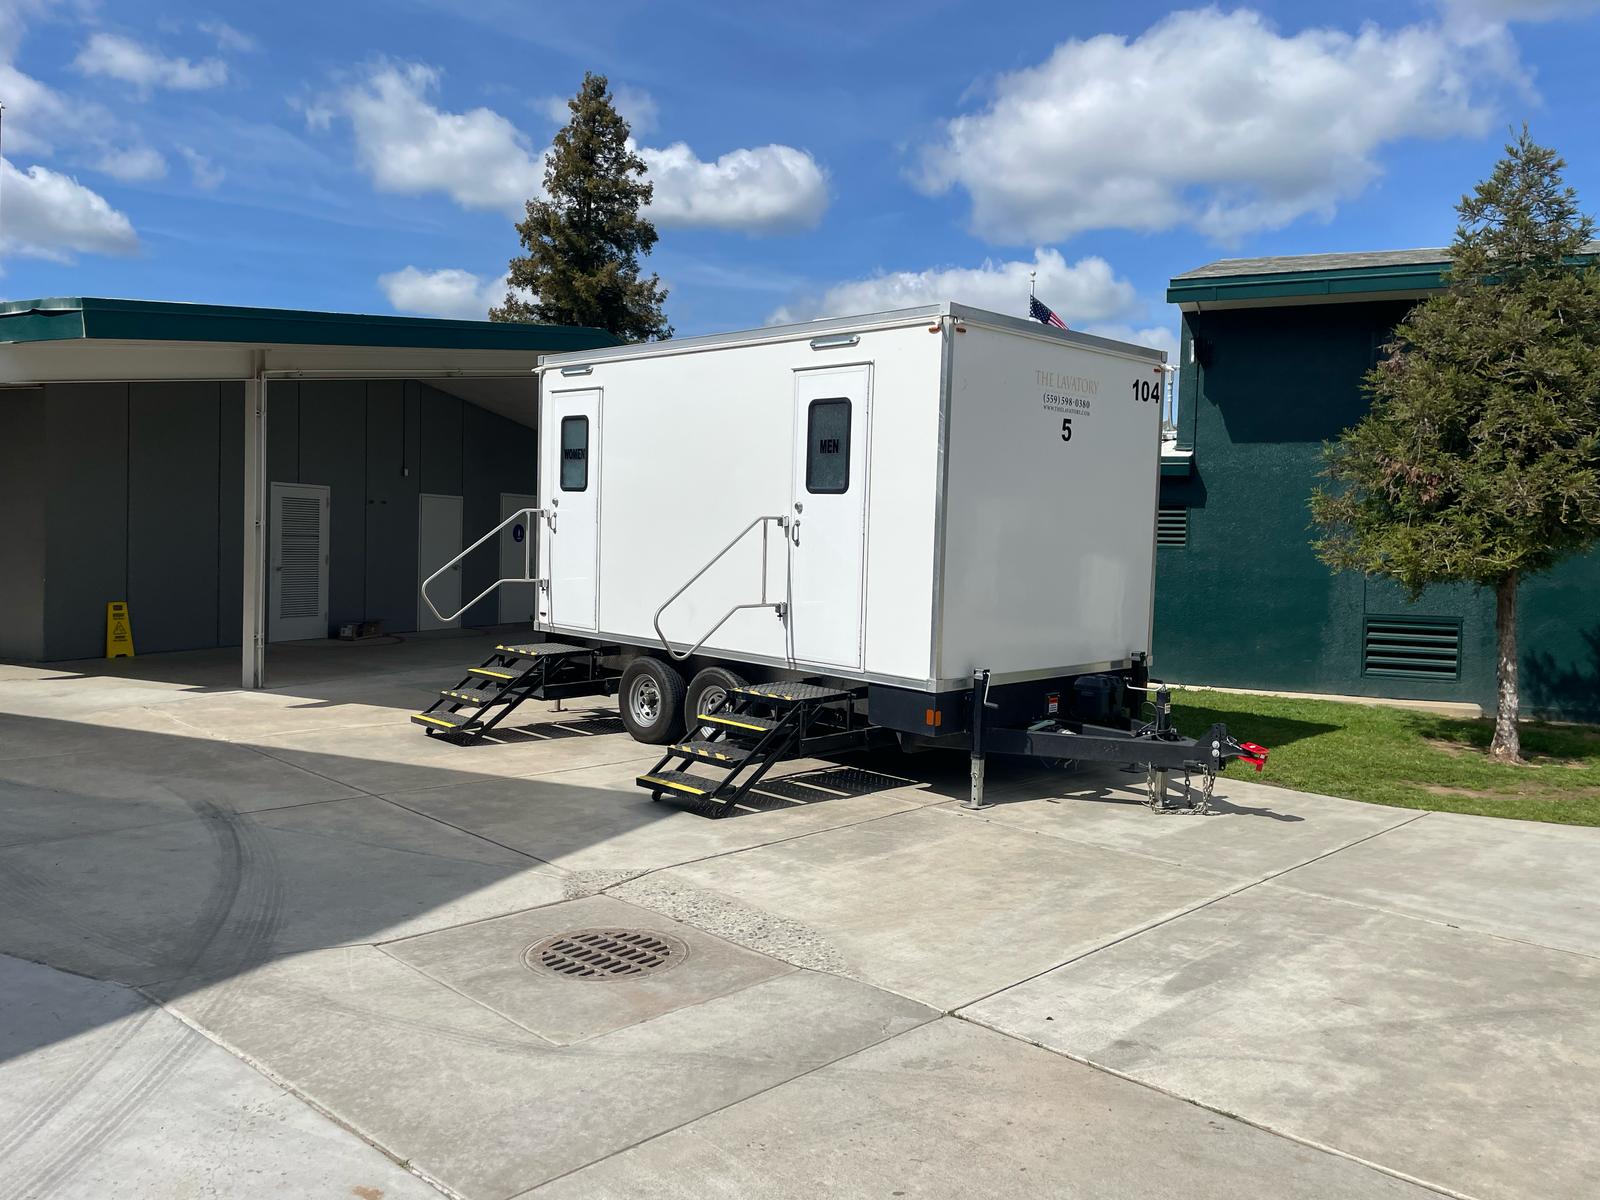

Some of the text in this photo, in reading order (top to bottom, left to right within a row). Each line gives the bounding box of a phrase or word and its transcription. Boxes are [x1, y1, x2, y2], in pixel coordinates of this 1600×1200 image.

[1035, 369, 1099, 395] THE LAVATORY
[1132, 379, 1160, 403] 104
[1061, 418, 1072, 441] 5
[564, 448, 586, 460] WOMEN
[820, 439, 839, 454] MEN
